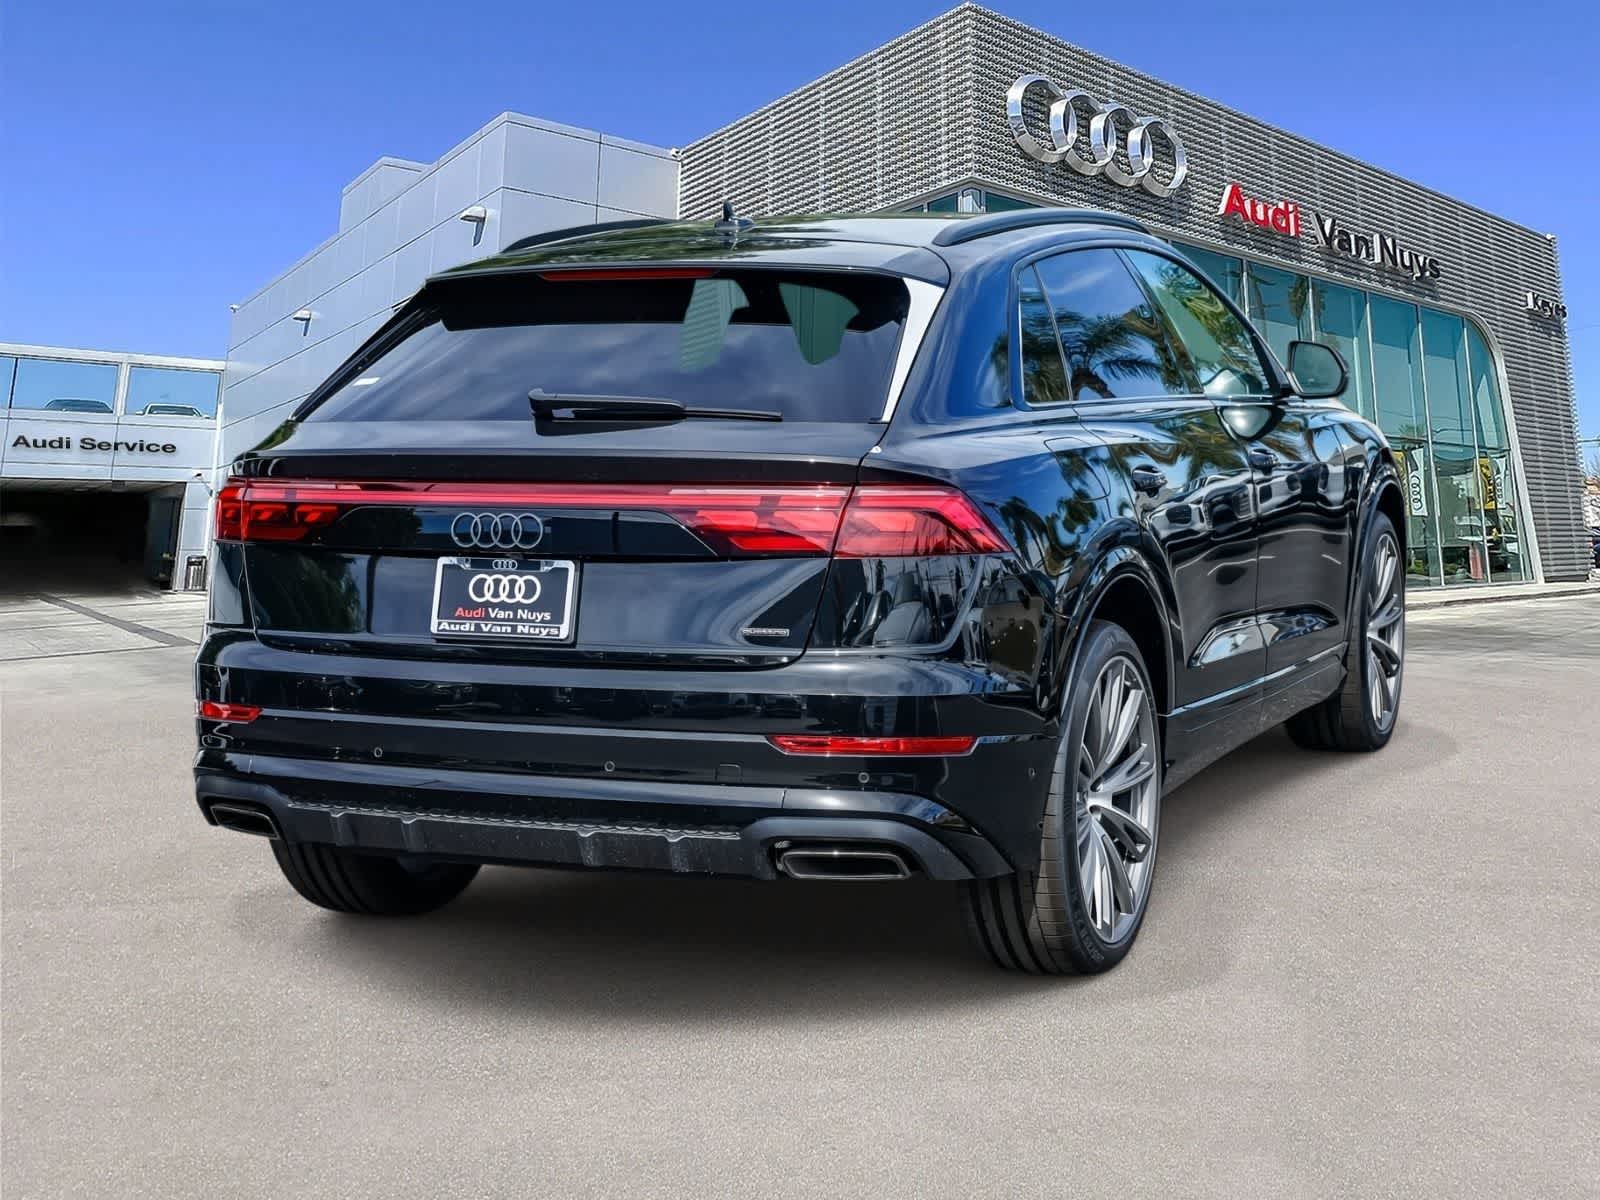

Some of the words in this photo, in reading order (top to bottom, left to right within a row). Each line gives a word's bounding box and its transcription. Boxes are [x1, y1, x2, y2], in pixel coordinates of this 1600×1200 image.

[1218, 183, 1301, 238] Audi
[1312, 212, 1370, 258] Van
[1374, 233, 1441, 281] Nuys
[1526, 292, 1568, 320] Keyes
[12, 434, 71, 450] Audi
[79, 437, 177, 454] Service
[455, 607, 485, 618] Audi
[488, 608, 513, 619] Van
[517, 609, 551, 622] Nuys
[438, 621, 475, 632] Audi
[480, 623, 511, 633] Van
[517, 625, 560, 636] Nuys
